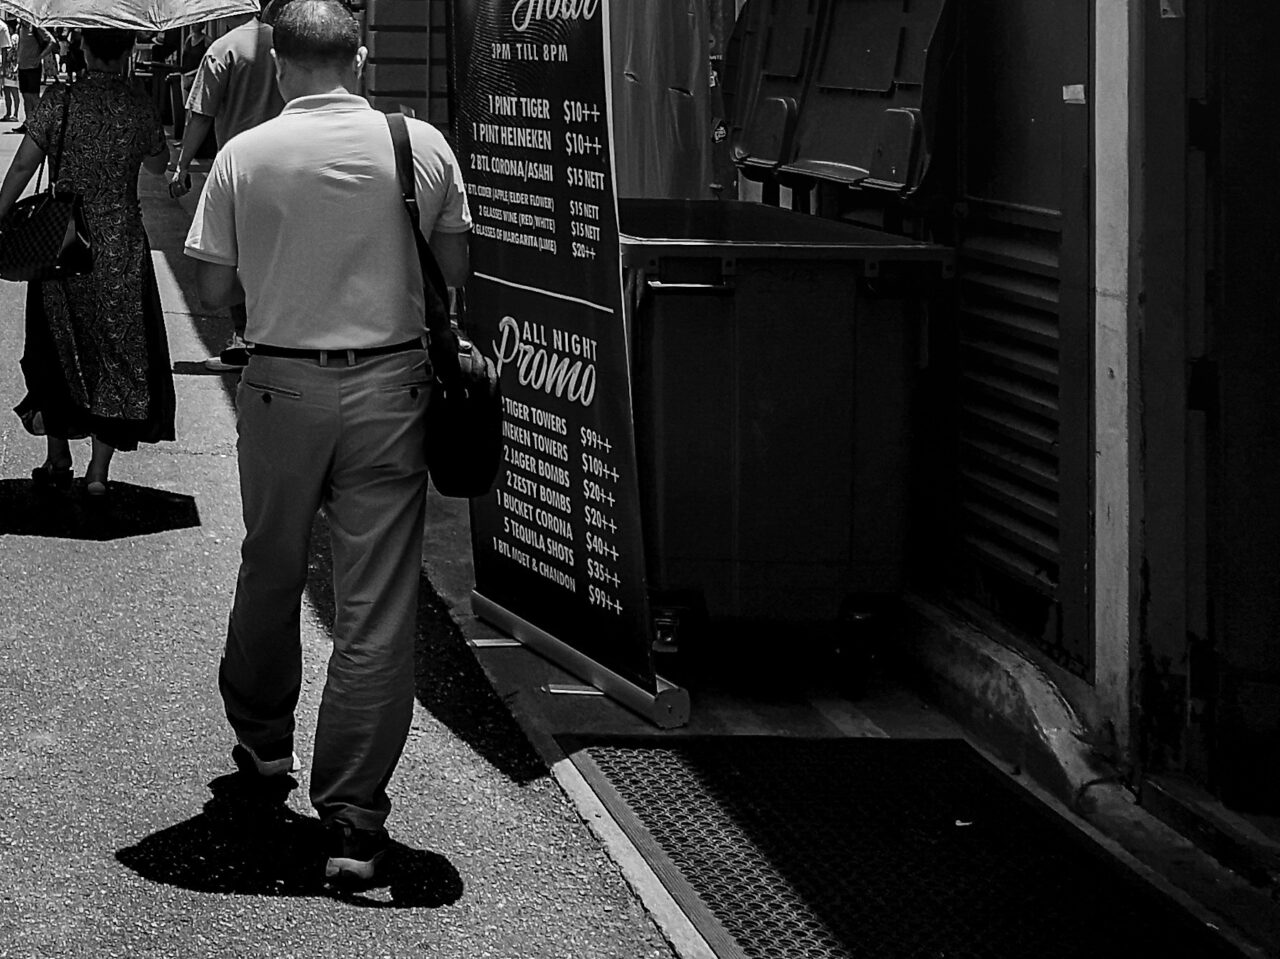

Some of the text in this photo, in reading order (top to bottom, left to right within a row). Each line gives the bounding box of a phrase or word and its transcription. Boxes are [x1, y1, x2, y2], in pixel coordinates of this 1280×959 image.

[491, 43, 568, 62] 3PM TILL 8PM
[488, 94, 601, 125] 1 PINT TIGER $10++
[472, 122, 602, 156] 1 PINT HEINEKEN $10++
[470, 153, 605, 191] 2 BTL CORONA/ASAHI $15 NETT
[478, 205, 483, 217] 2
[483, 205, 503, 221] GLASSES
[502, 210, 518, 224] WINE
[570, 221, 584, 237] $15
[584, 223, 601, 241] NETT
[569, 200, 583, 216] $15
[583, 203, 600, 220] NETT
[475, 224, 496, 239] GLASSES
[496, 228, 503, 240] OF
[502, 230, 539, 248] MARGARITA
[571, 241, 597, 260] $20++
[492, 315, 596, 407] Promo
[522, 320, 597, 362] ALL NIGHT
[505, 397, 530, 422] TIGER
[530, 407, 567, 436] TOWERS
[580, 426, 612, 454] $99++
[502, 420, 620, 483] INEKEN TOWERS $109++
[503, 444, 616, 507] 2 JAGER BOMBS $20++
[496, 488, 620, 561] 1 BUCKET CORONA $40++
[506, 470, 618, 534] 2 ZESTY BOMBS $20++
[493, 536, 623, 615] 1 BTL MOET & CHANDON $99++
[503, 516, 621, 588] 5 TEQUILA SHOTS $35++
